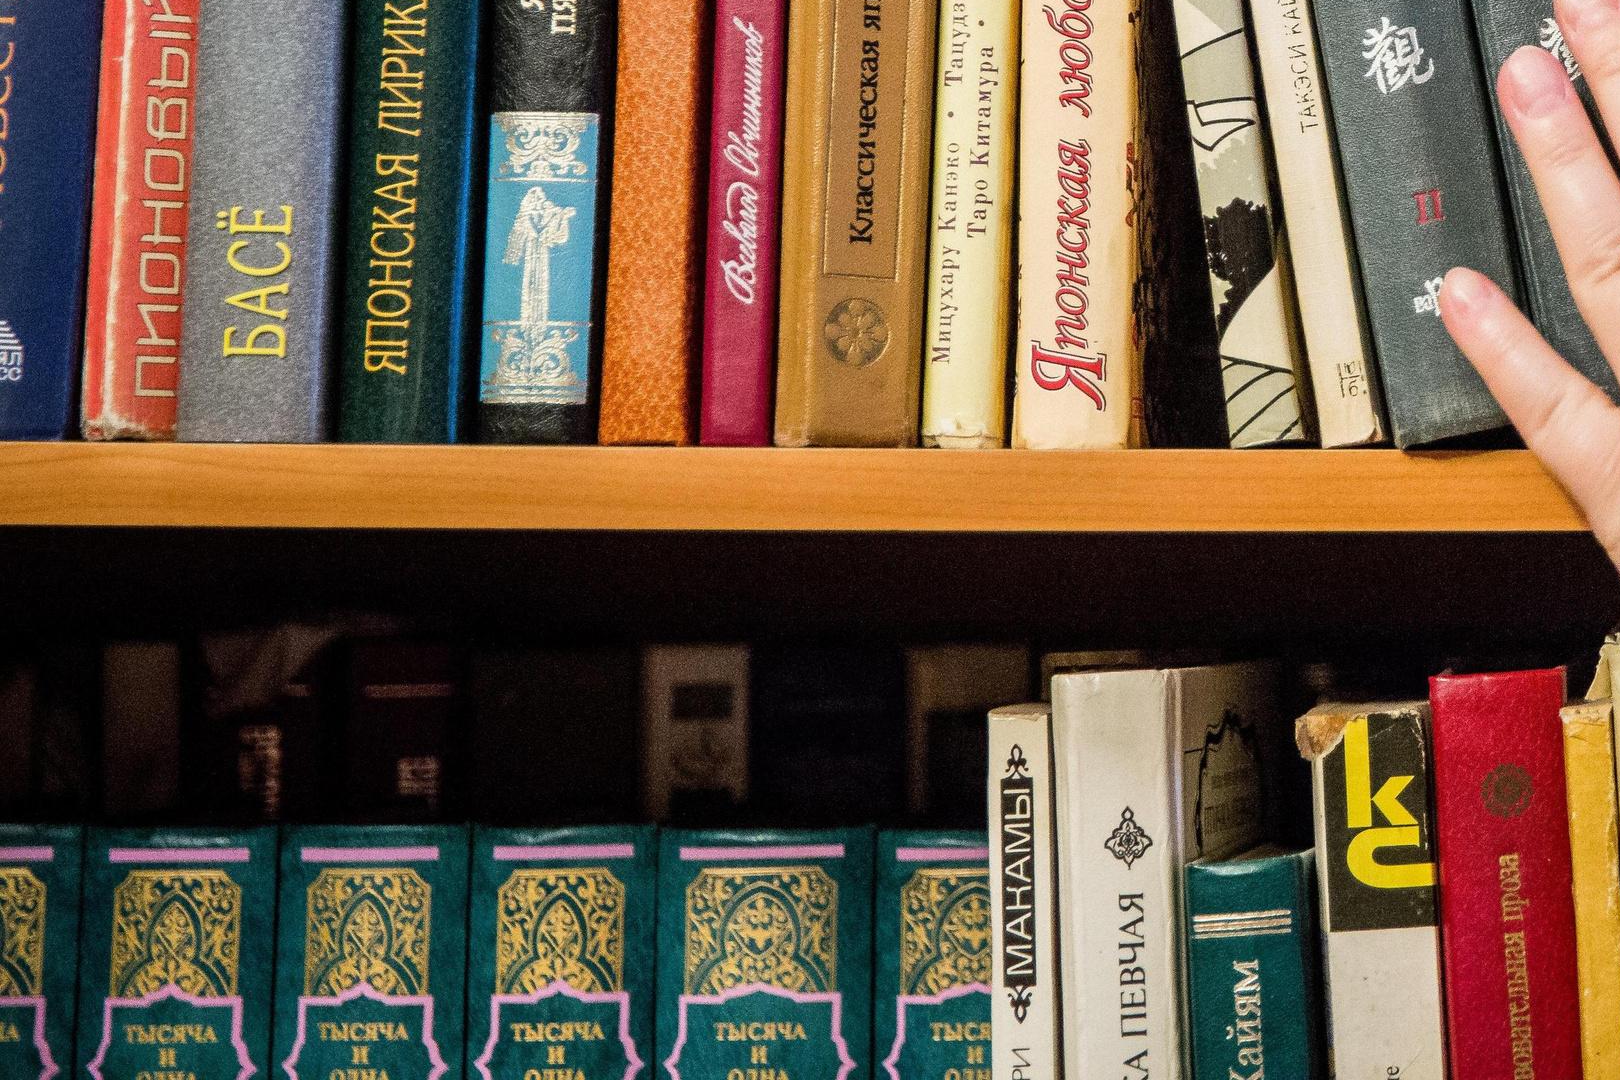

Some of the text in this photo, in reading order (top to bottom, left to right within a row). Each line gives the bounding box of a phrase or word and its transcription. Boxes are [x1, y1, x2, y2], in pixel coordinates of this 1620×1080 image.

[970, 46, 998, 169] Китамура
[1285, 44, 1320, 134] ТАКЭСИ
[848, 40, 880, 245] Классическая
[939, 141, 960, 231] Канэко
[966, 174, 993, 239] Таро
[216, 205, 293, 359] БАСЁ
[363, 151, 420, 375] ЯПОНСКАЯ
[931, 246, 961, 364] Мицухару
[1031, 138, 1107, 413] Японская
[1002, 788, 1034, 976] МАКАМЫ
[1498, 851, 1531, 924] проза
[1118, 892, 1148, 1038] ПЕВЧАЯ
[123, 1023, 218, 1045] ТЫСЯЧА
[317, 1021, 409, 1042] ТЫСЯЧА
[511, 1021, 606, 1042] ТЫСЯЧА
[713, 1021, 807, 1042] ТЫСЯЧА
[930, 1021, 992, 1042] ТЫСЯ
